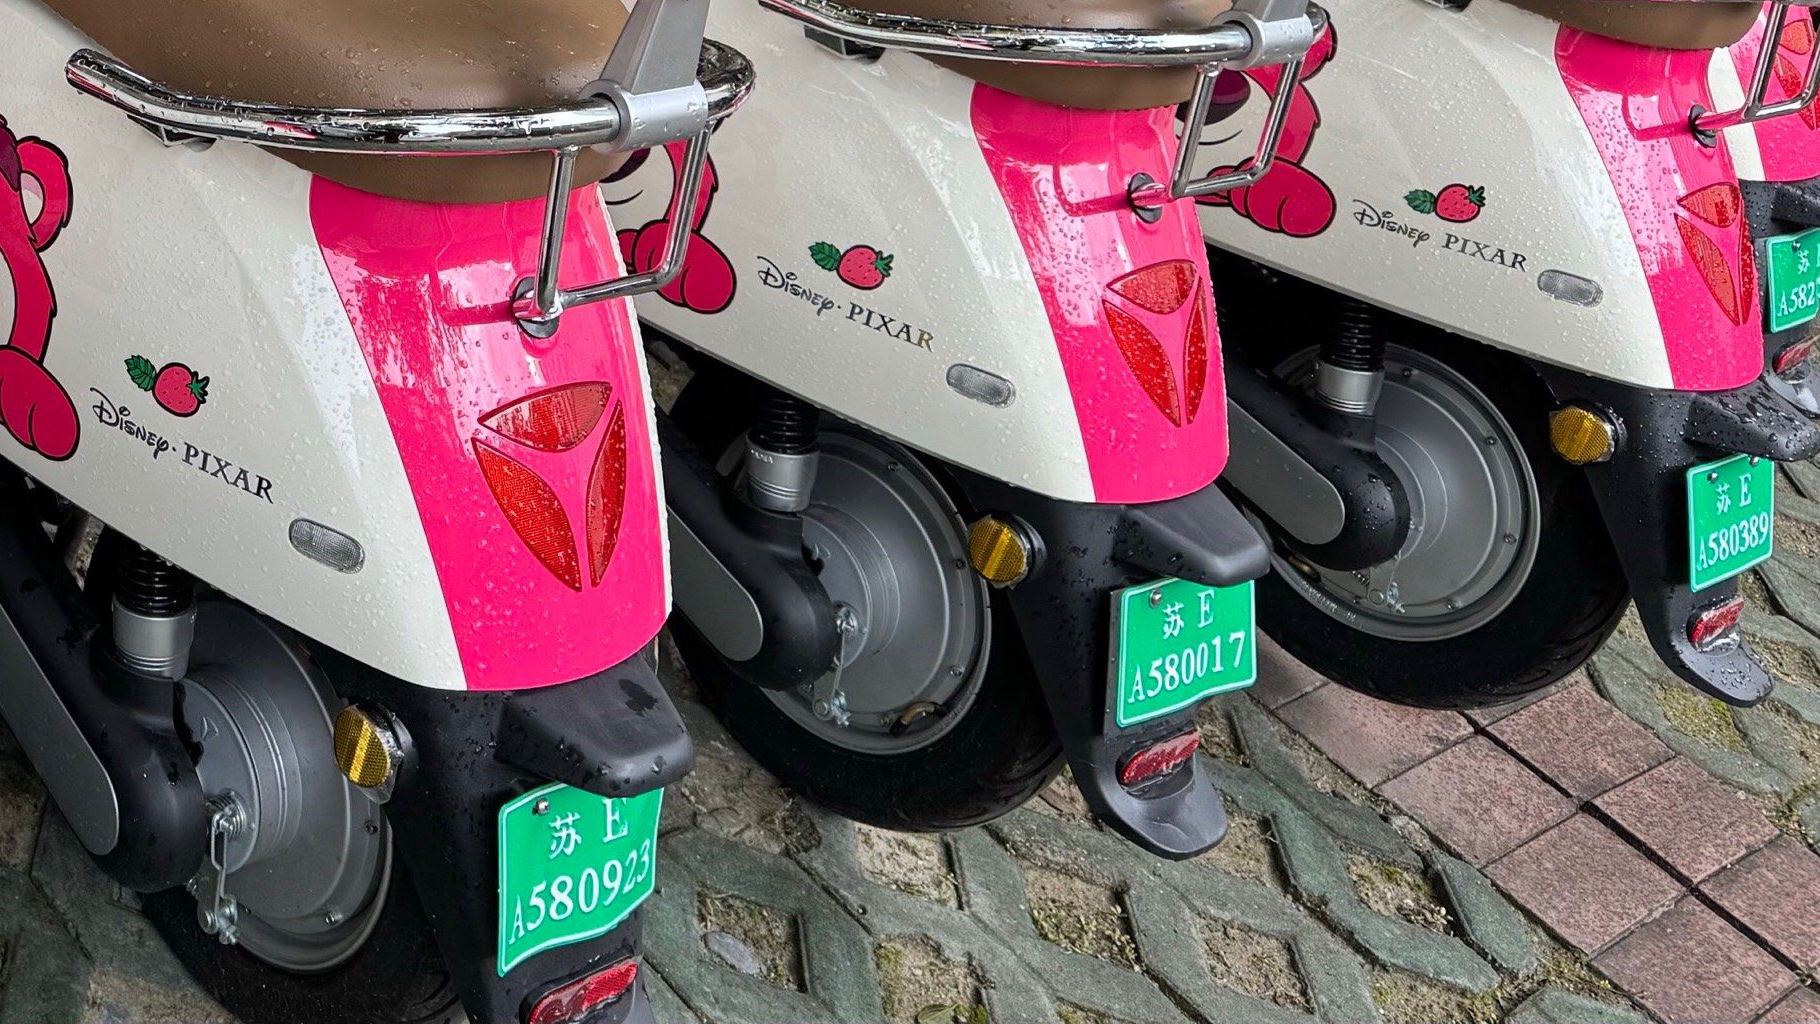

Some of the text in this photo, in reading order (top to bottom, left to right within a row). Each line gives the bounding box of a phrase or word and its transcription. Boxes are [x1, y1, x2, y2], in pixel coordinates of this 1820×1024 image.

[1353, 199, 1527, 272] Disney PIXAR
[757, 256, 934, 353] Disney PIXAR
[90, 387, 273, 504] Disney PIXAR
[1716, 473, 1752, 515] 苏 E
[1696, 511, 1769, 571] A580389
[1162, 589, 1215, 640] 苏 E
[1128, 630, 1246, 704] A580017
[548, 797, 629, 859] 苏 E
[508, 838, 651, 945] A580923
